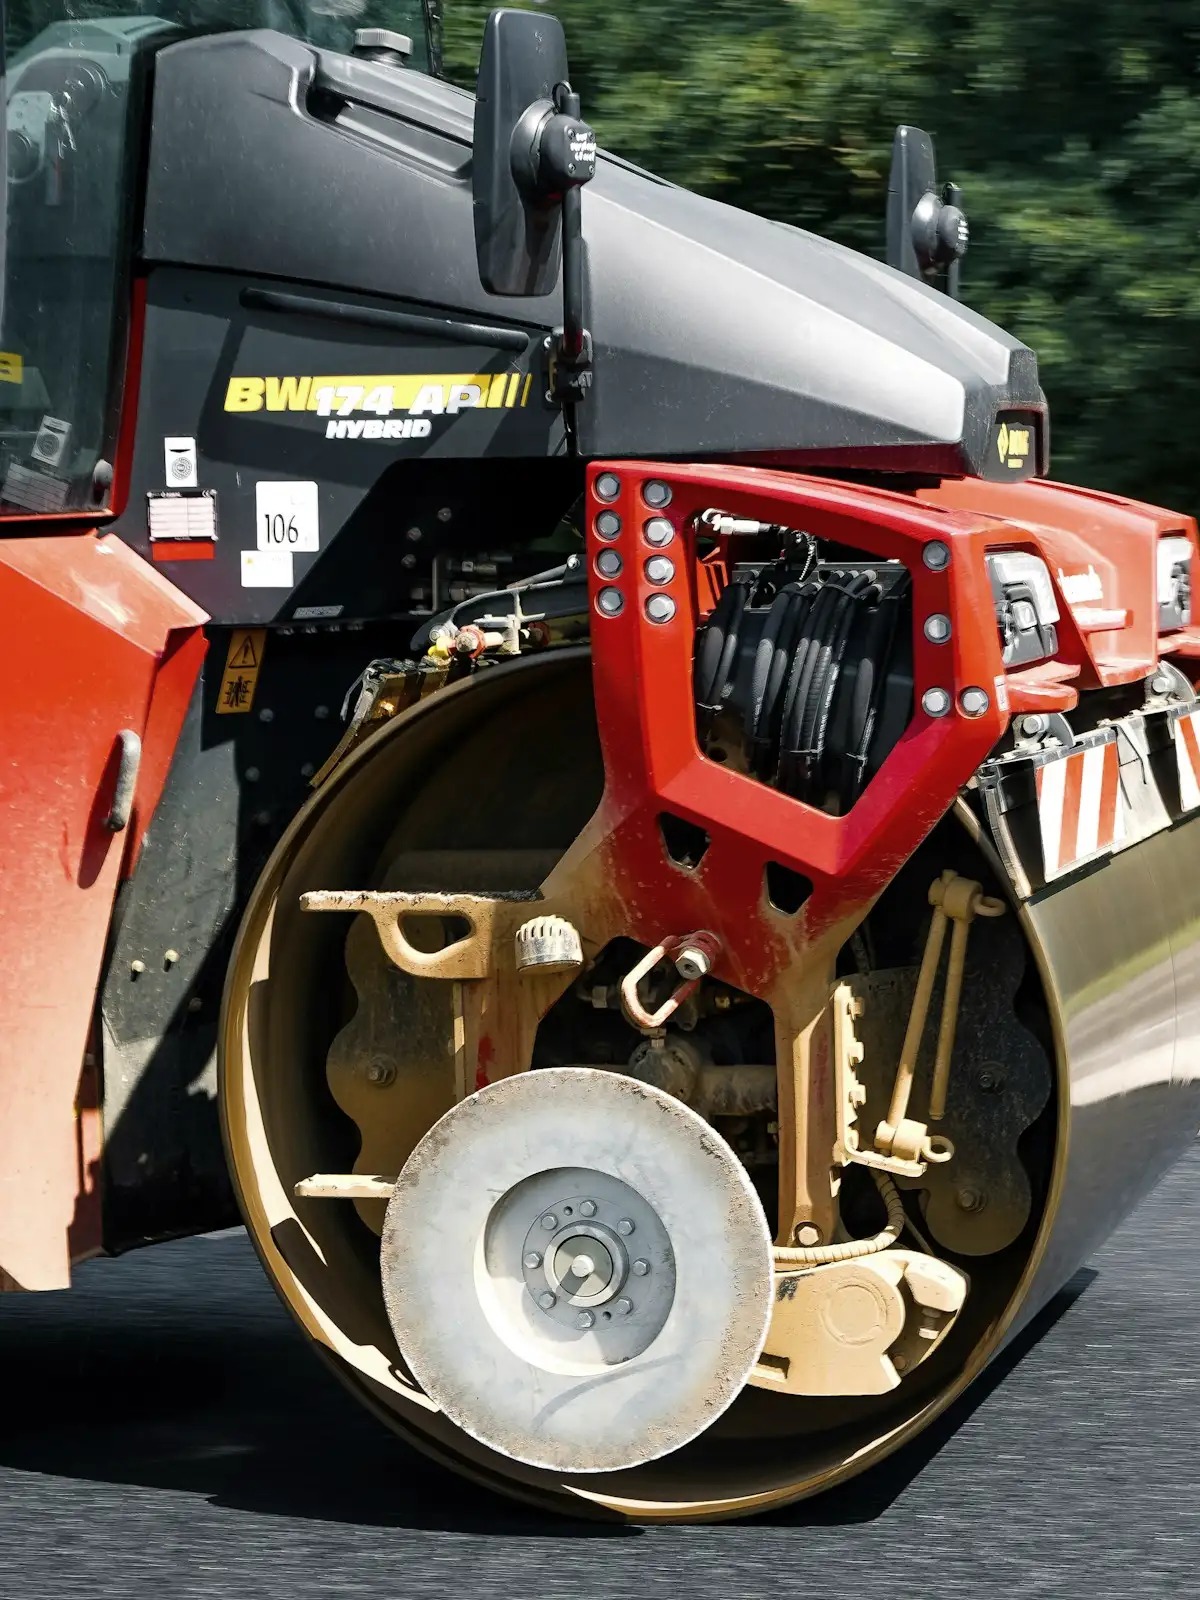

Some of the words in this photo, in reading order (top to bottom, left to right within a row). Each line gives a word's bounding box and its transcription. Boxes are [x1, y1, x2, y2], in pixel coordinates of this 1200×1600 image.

[224, 376, 313, 412] BW
[315, 384, 395, 416] 174
[408, 384, 482, 415] AP
[325, 419, 432, 439] HYBRID
[264, 513, 299, 544] 106
